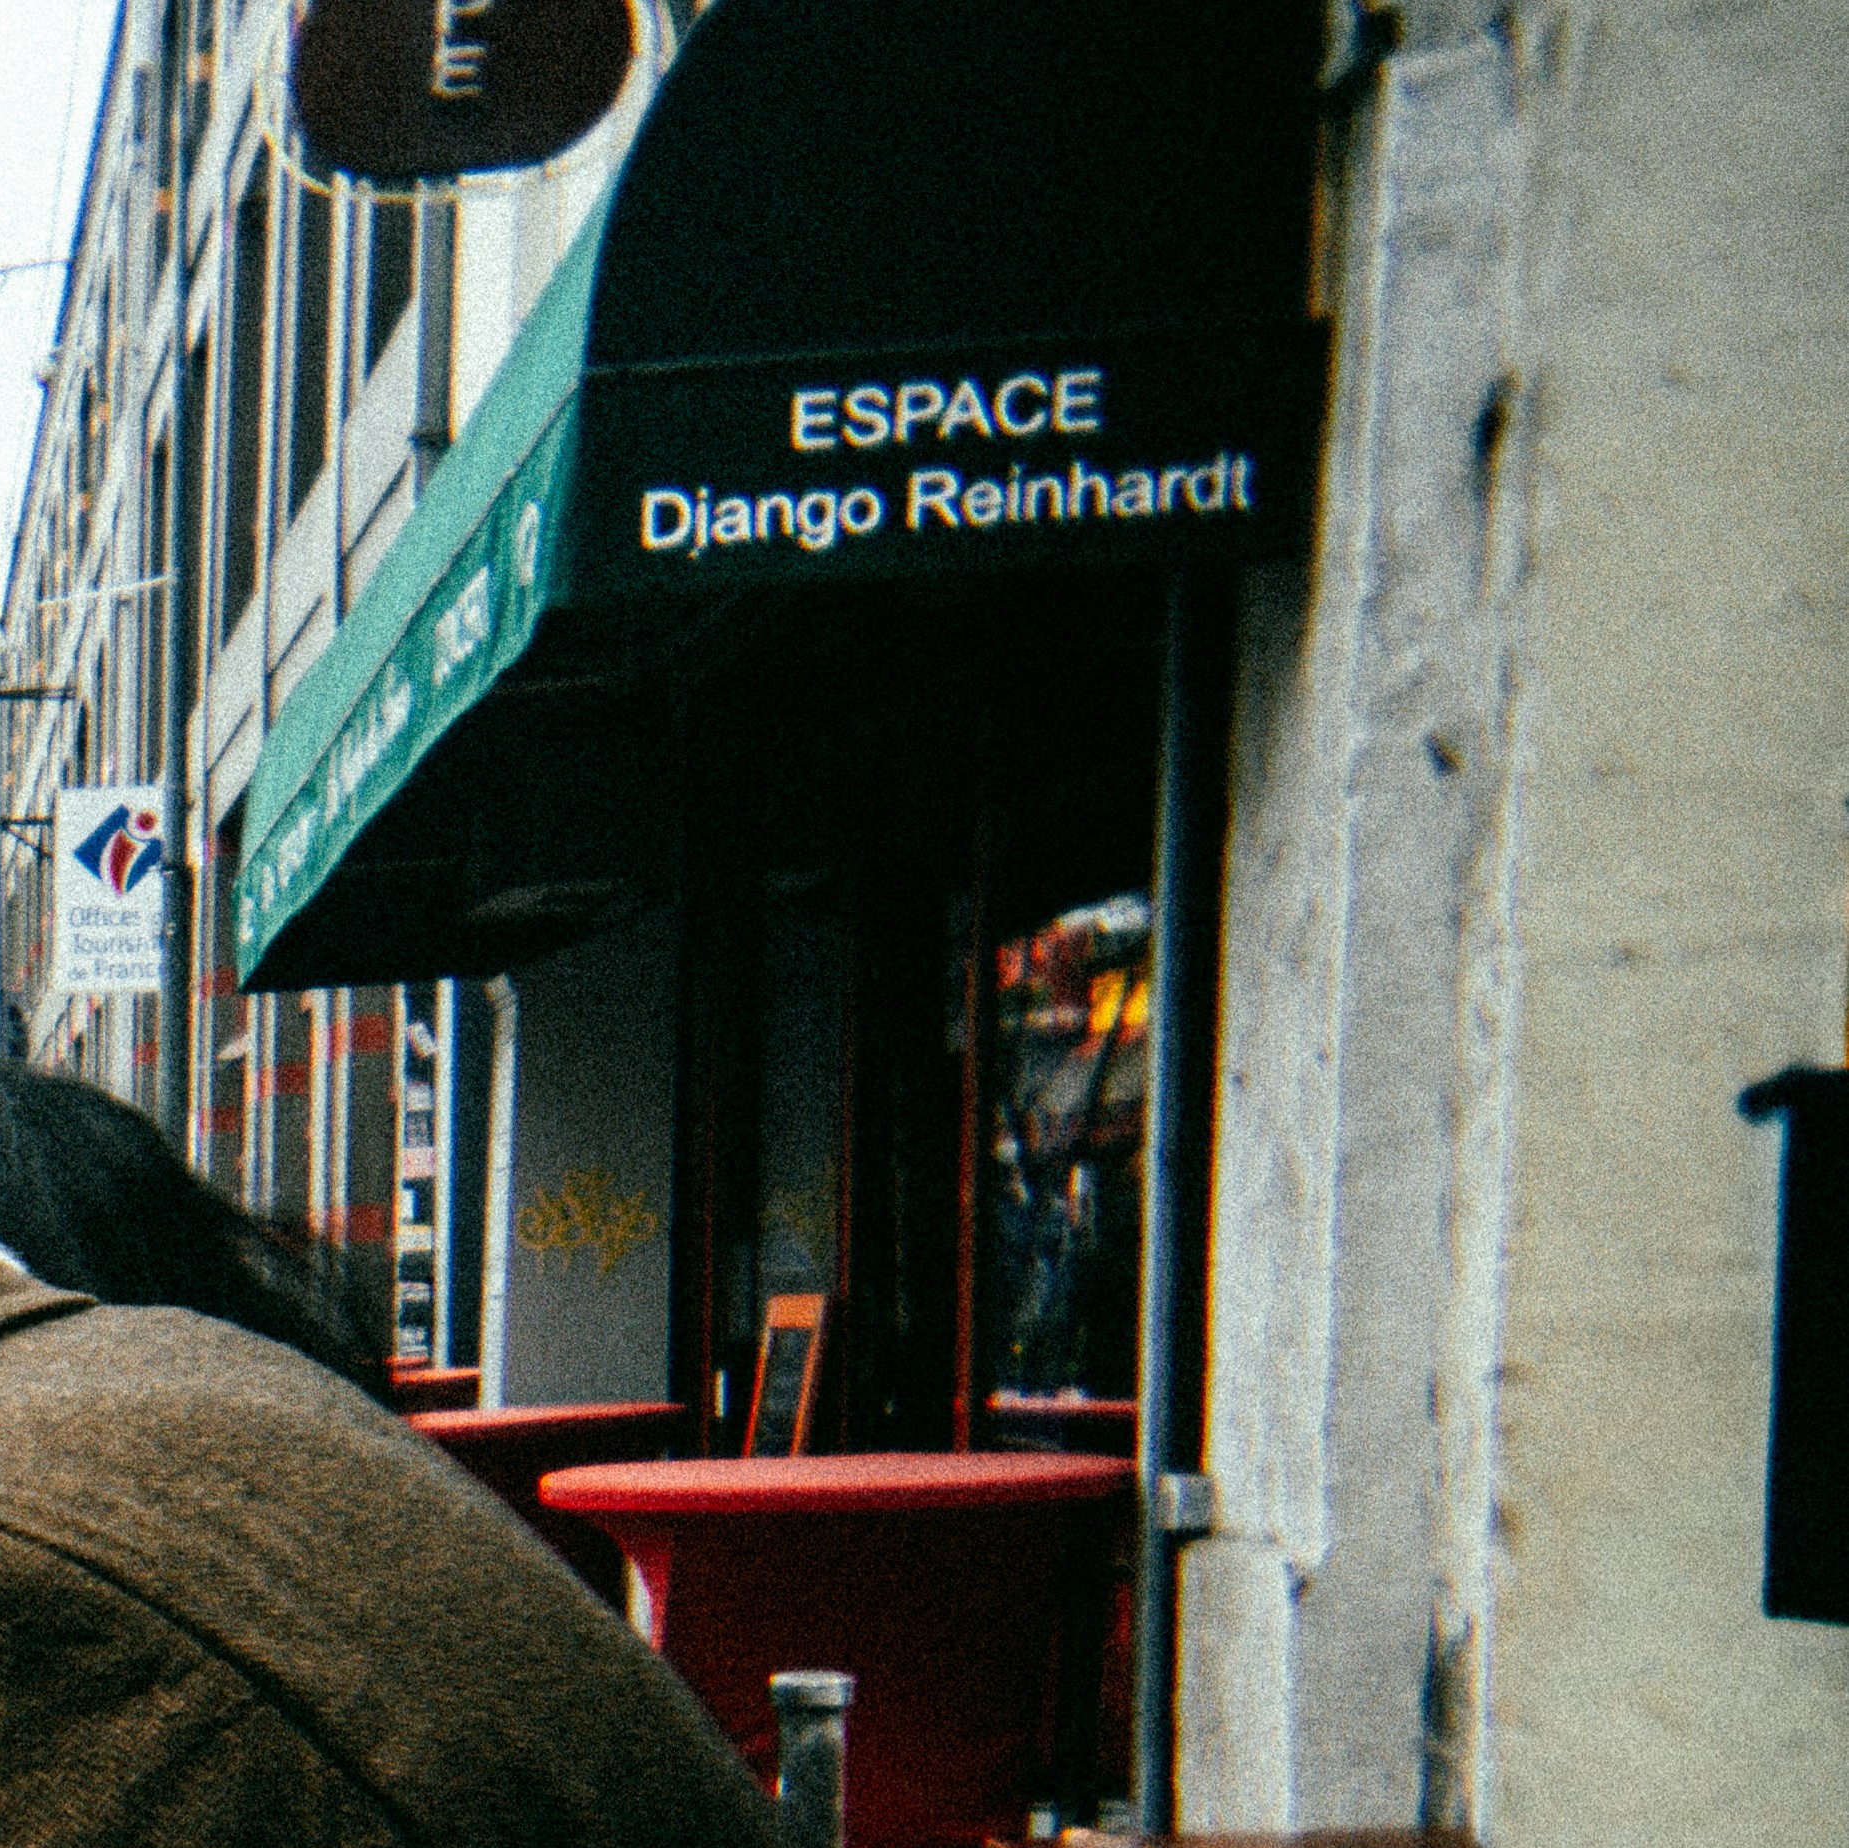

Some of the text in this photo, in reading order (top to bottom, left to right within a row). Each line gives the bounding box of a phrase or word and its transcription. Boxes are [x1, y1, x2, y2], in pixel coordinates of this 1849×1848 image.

[790, 370, 1102, 452] ESPACE
[640, 452, 1253, 558] Django Reinhardt
[94, 958, 159, 980] Franc
